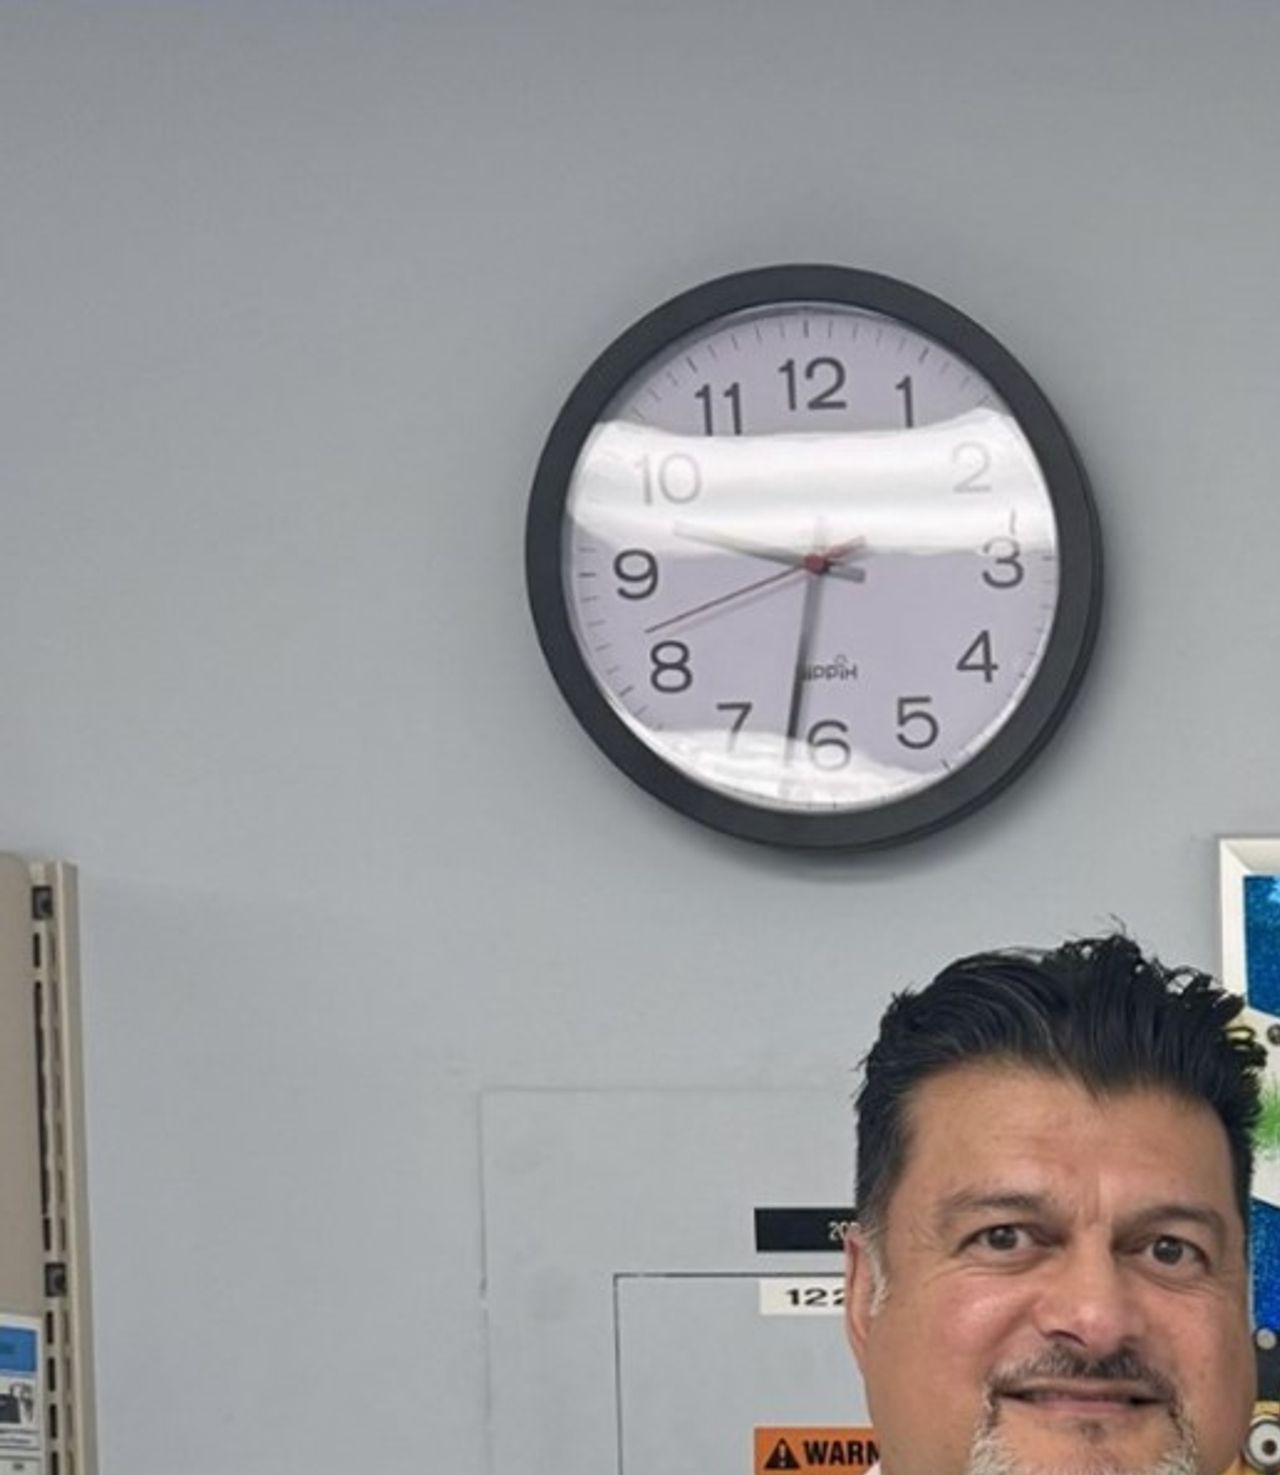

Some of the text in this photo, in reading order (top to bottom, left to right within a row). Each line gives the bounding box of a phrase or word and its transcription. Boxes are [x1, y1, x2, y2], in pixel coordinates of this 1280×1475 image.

[694, 382, 743, 437] 11
[778, 357, 847, 411] 12
[895, 375, 915, 430] 1
[635, 452, 703, 506] 10
[952, 441, 993, 494] 2
[613, 549, 659, 600] 9
[981, 536, 1024, 589] 3
[650, 640, 693, 694] 8
[956, 630, 999, 684] 4
[716, 702, 753, 754] 7
[806, 719, 852, 772] 6
[895, 696, 939, 750] 5
